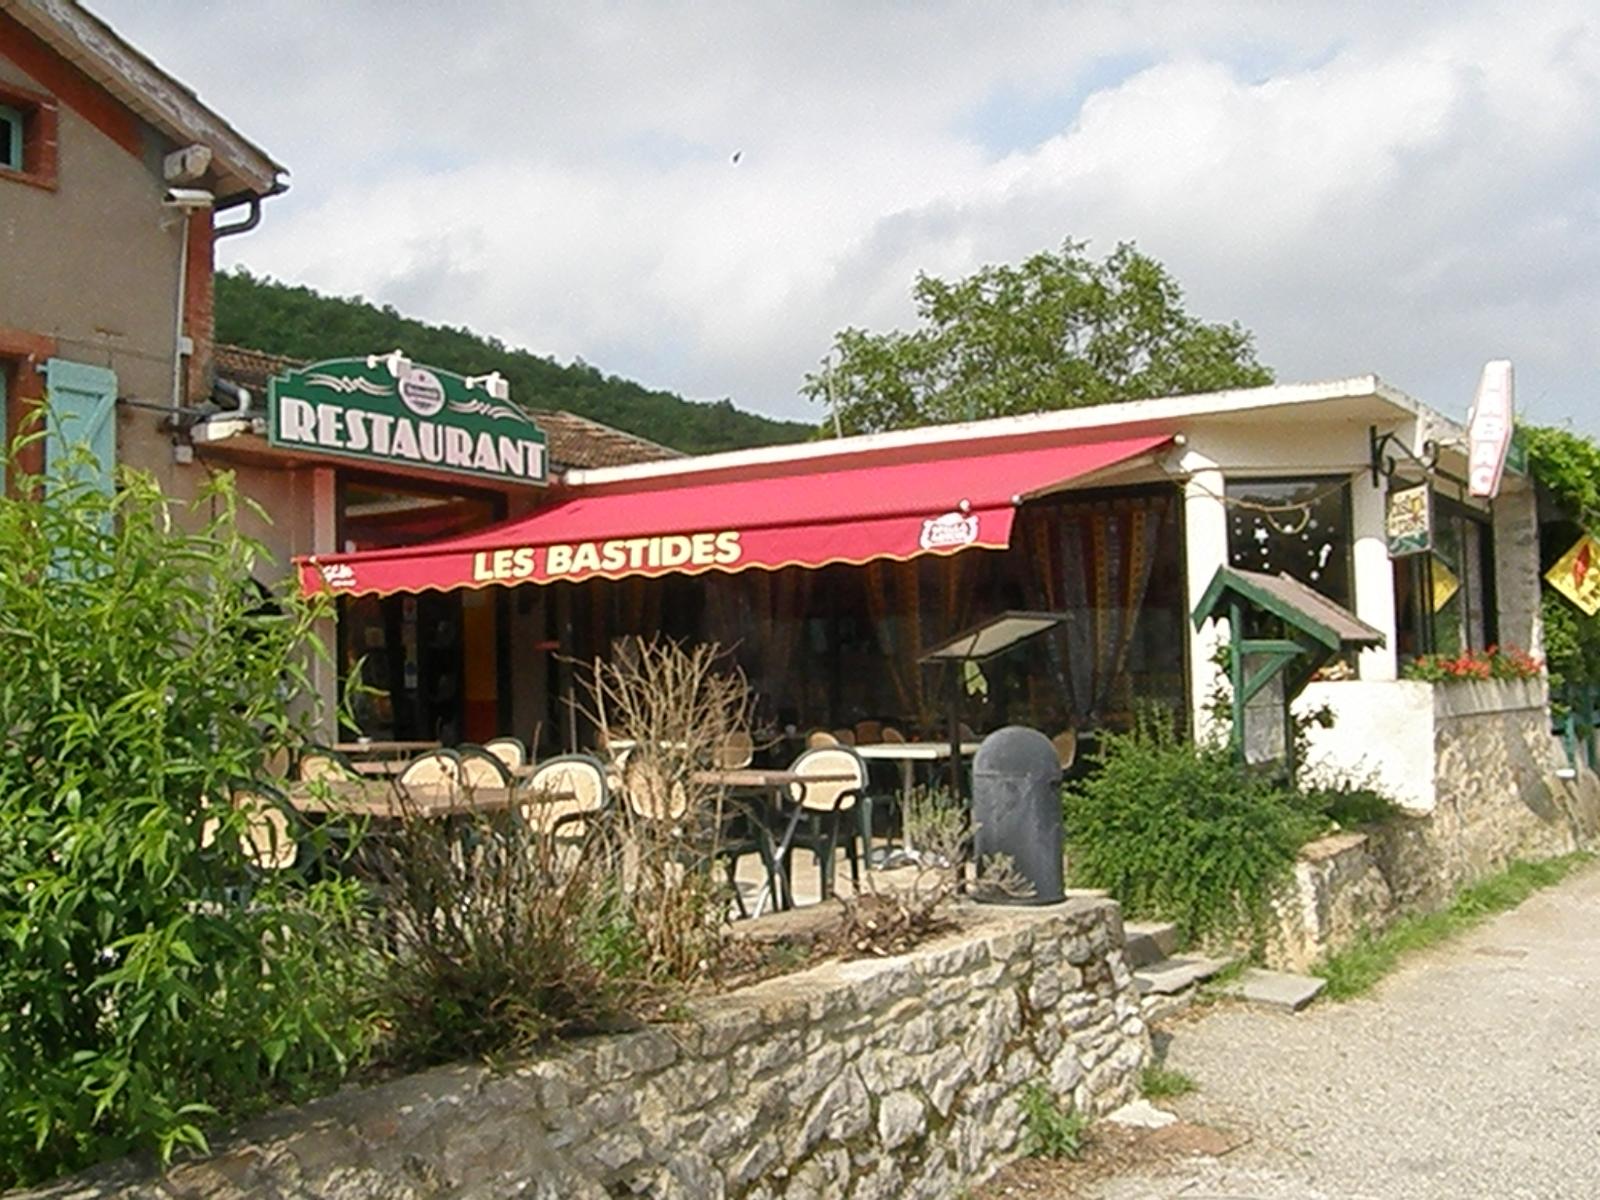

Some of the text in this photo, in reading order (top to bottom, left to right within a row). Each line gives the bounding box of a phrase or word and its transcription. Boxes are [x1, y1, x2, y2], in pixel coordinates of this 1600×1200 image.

[279, 396, 546, 479] RESTAURANT
[474, 532, 741, 580] LES BASTIDES
